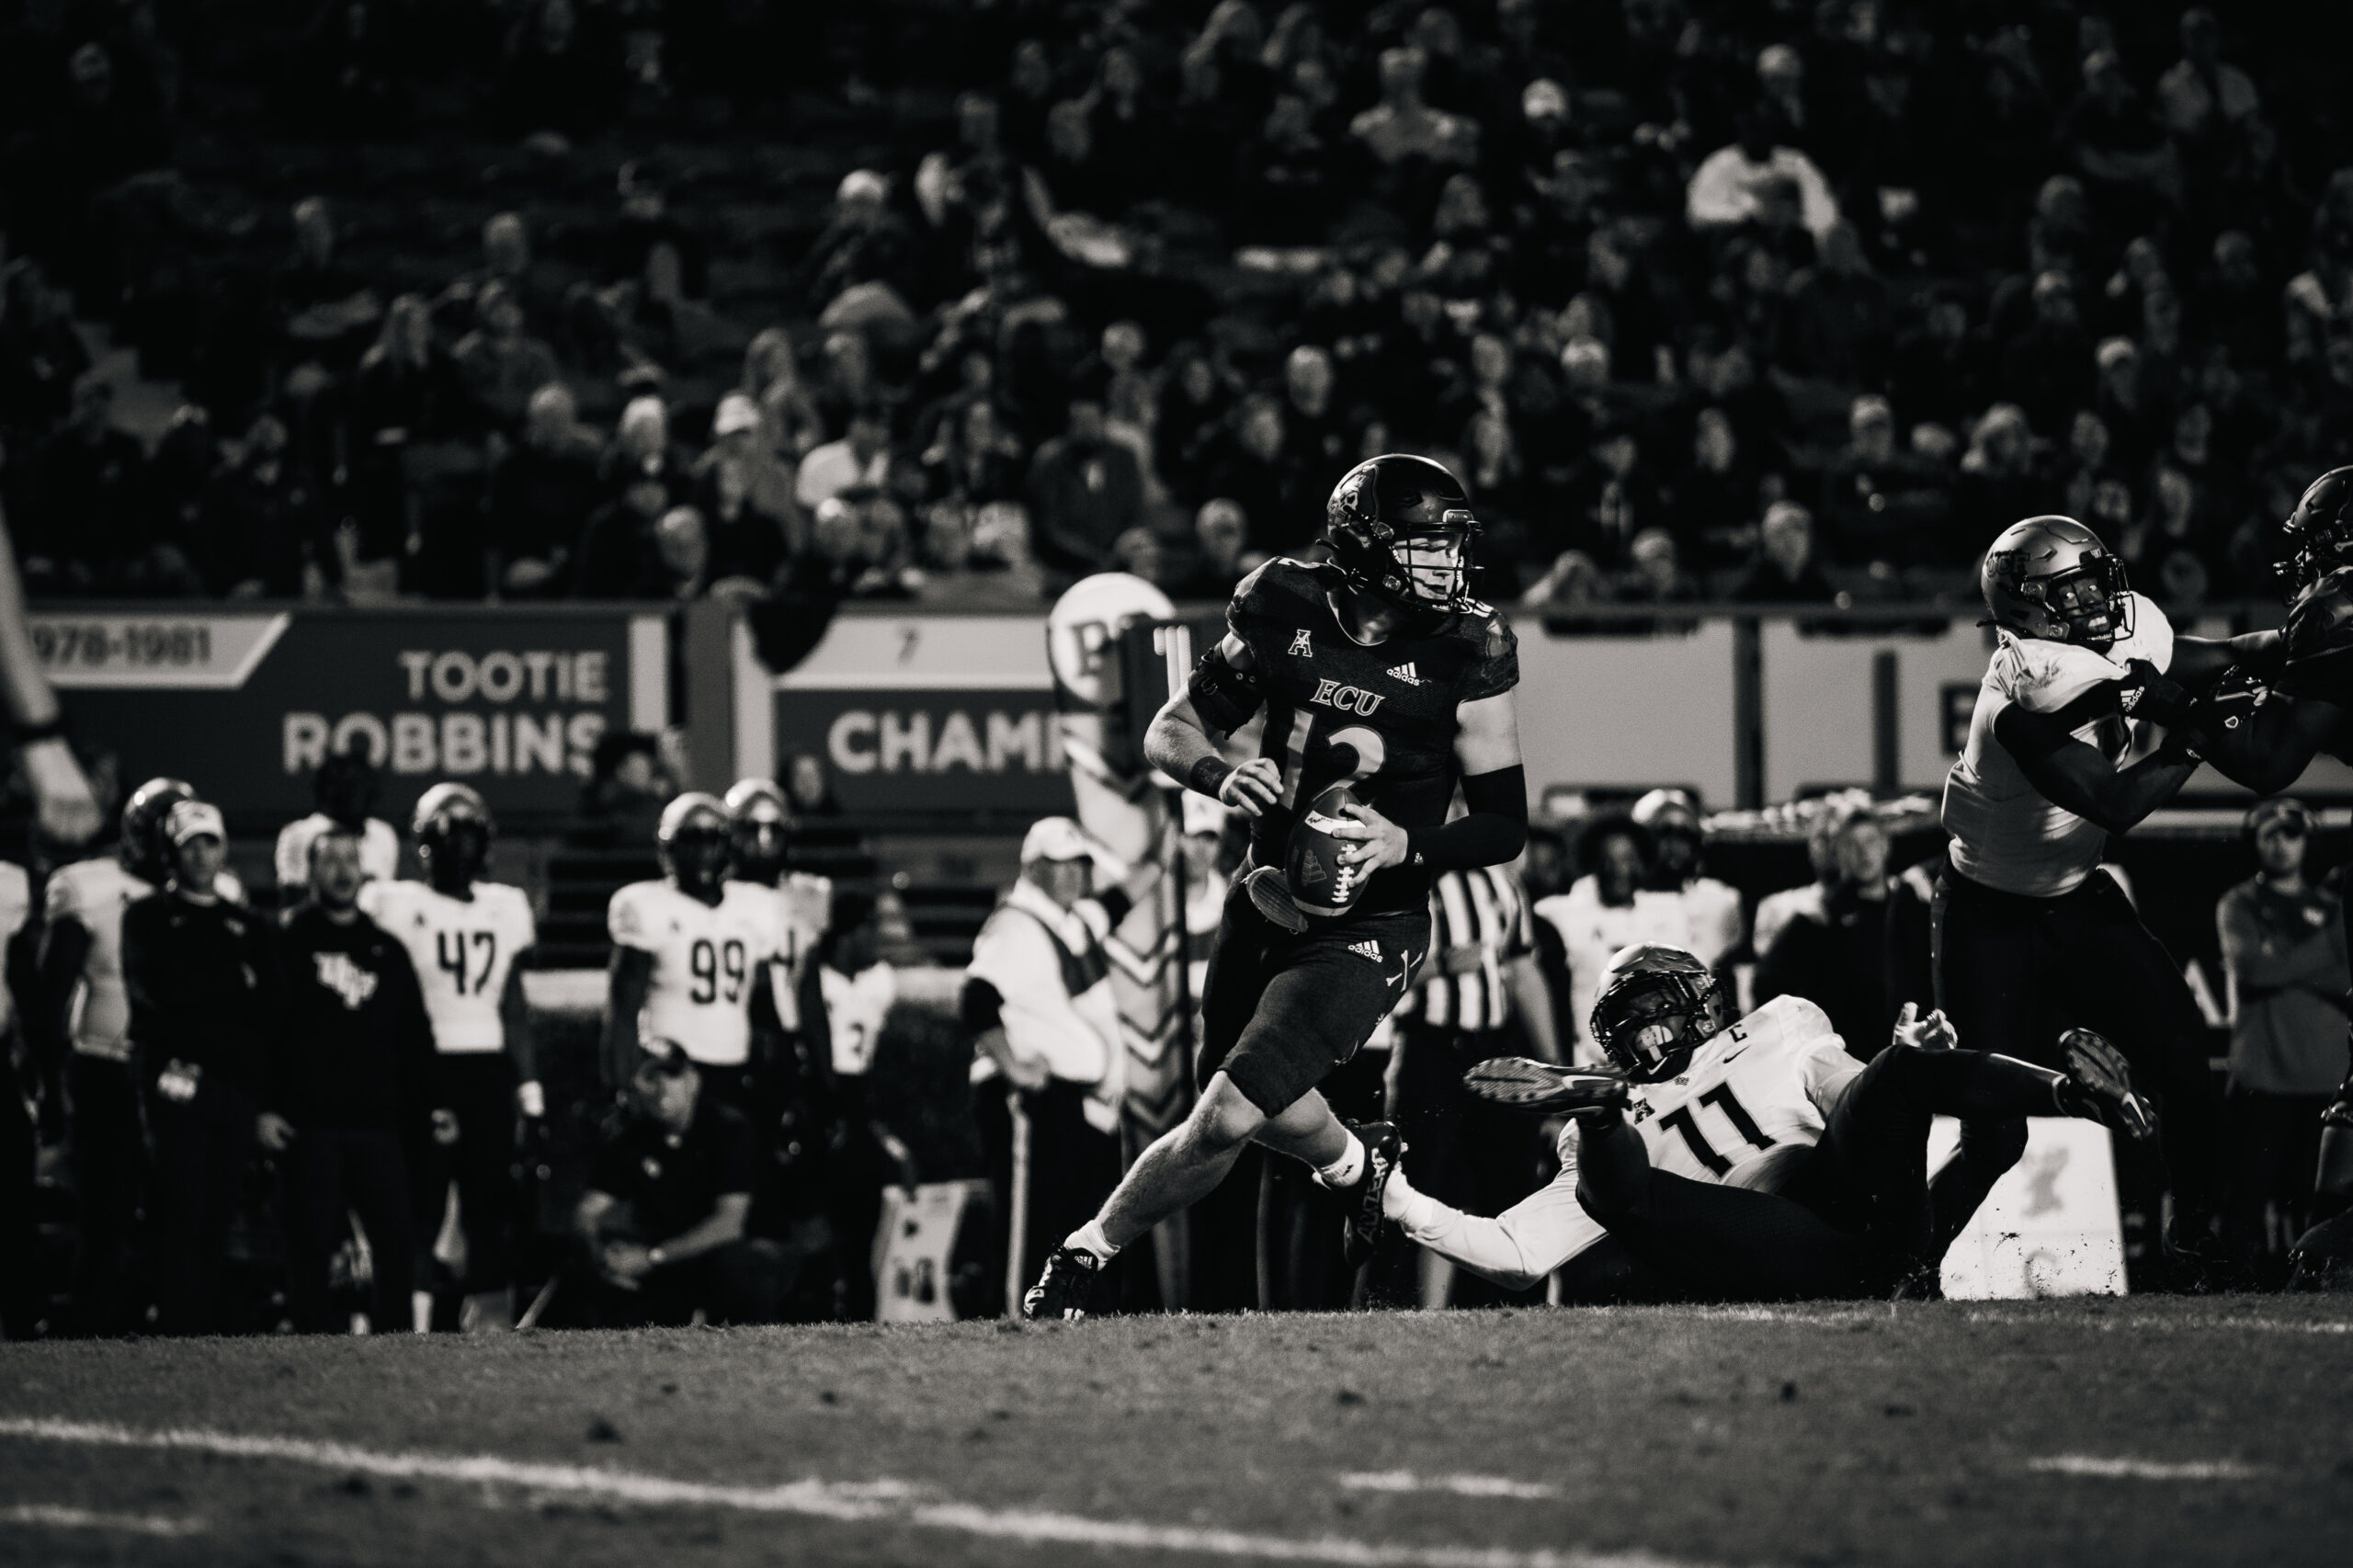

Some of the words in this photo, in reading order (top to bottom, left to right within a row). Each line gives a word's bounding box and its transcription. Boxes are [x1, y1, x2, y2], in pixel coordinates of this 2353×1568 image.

[31, 625, 211, 665] 978-1981
[399, 650, 608, 703] TOOTIE
[1309, 678, 1386, 717] ECU
[1386, 667, 1420, 687] adidas
[281, 710, 607, 778] ROBBINS
[437, 930, 496, 996] 47
[689, 937, 745, 1005] 99
[1347, 944, 1383, 963] adidas
[1655, 1078, 1779, 1182] 11
